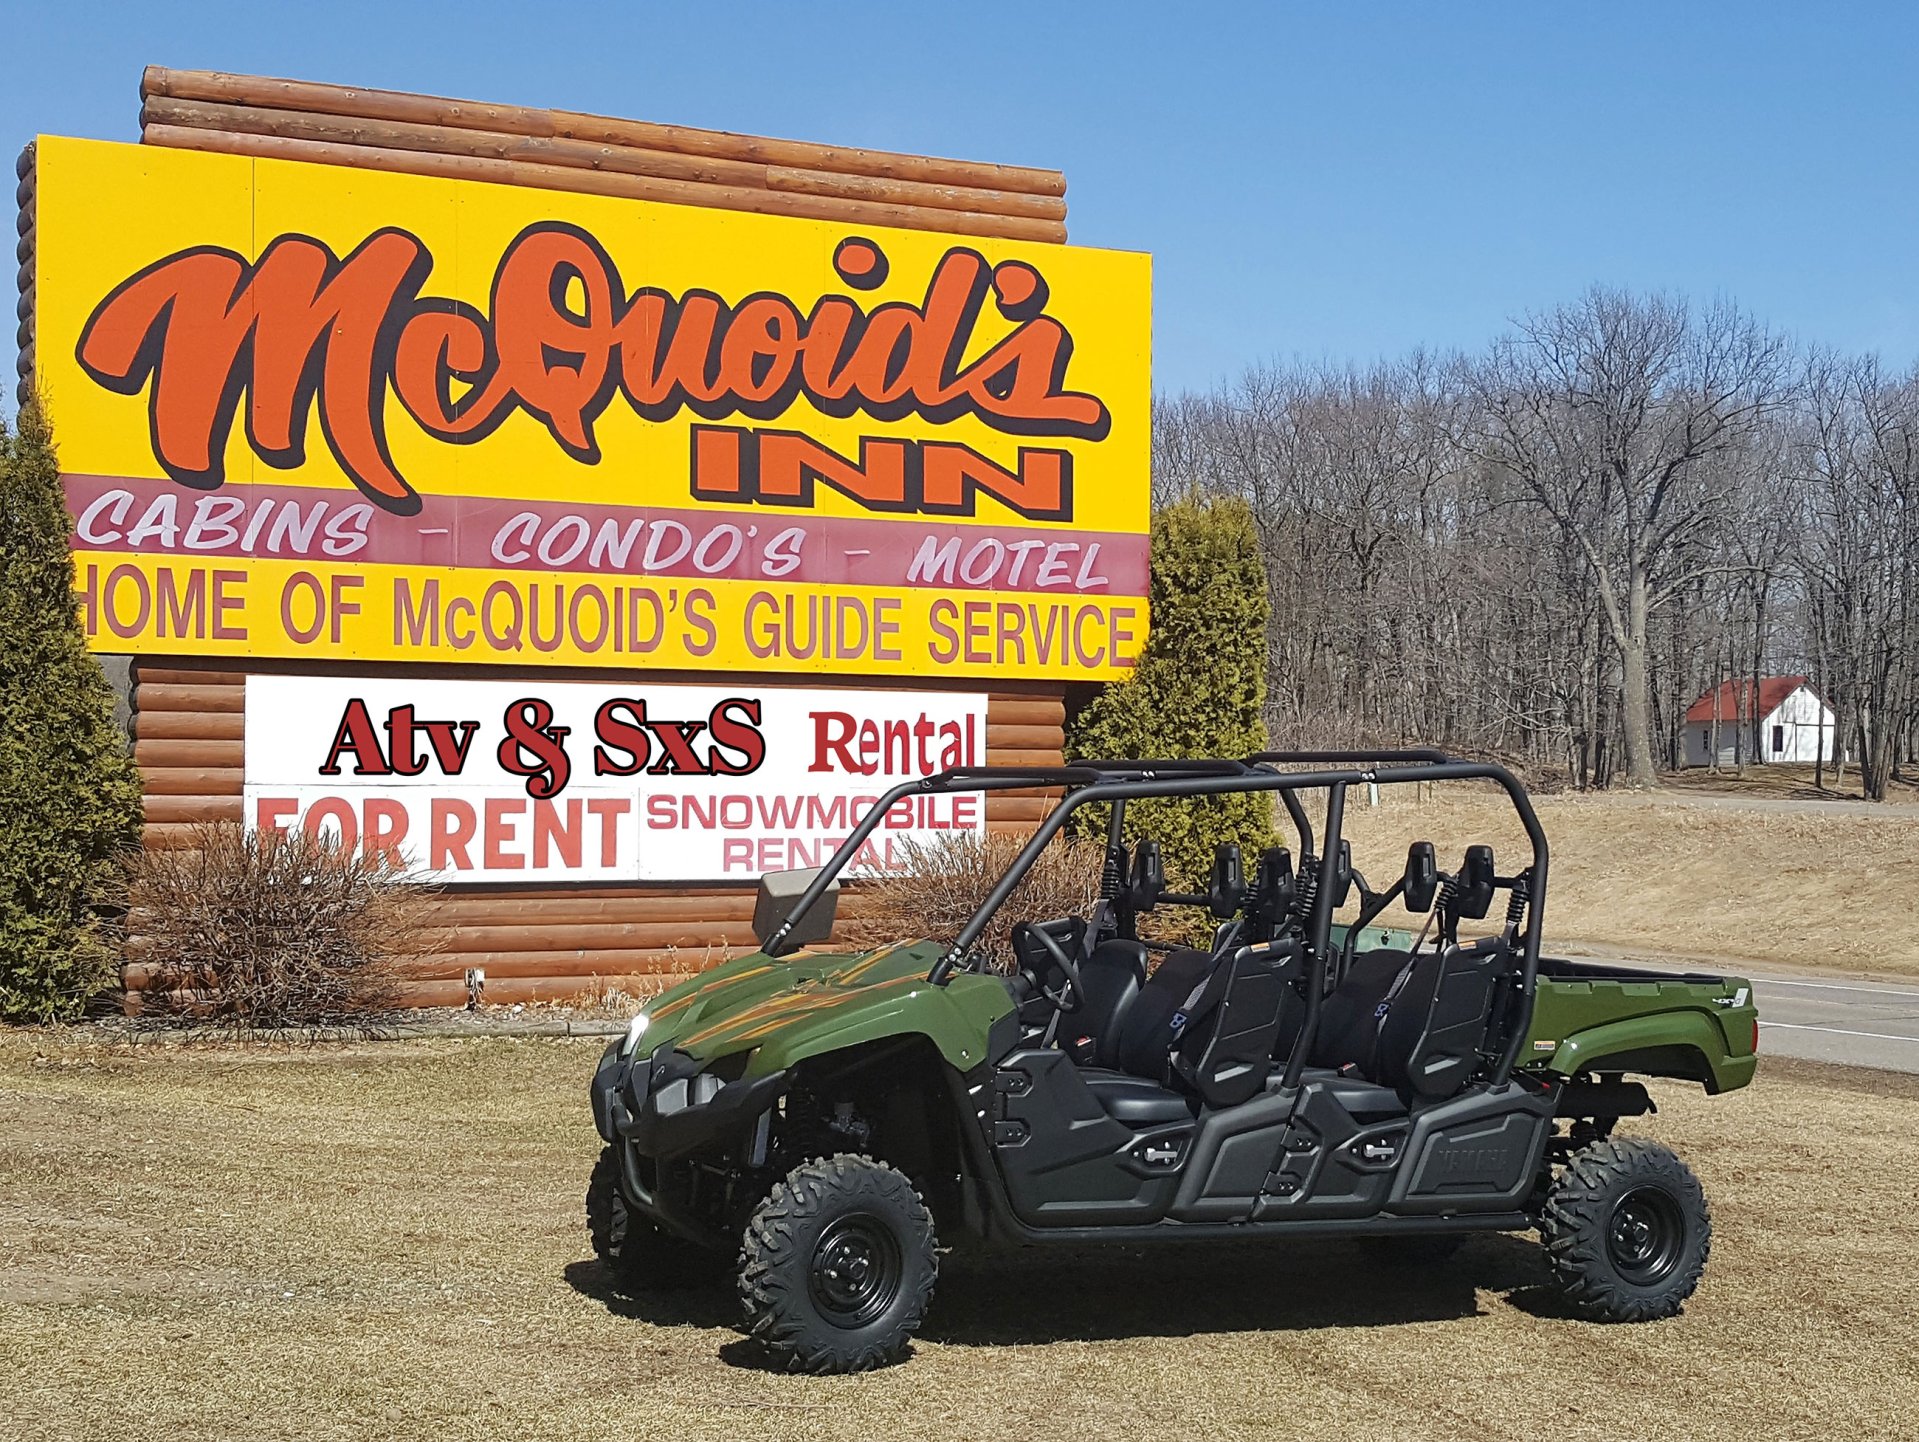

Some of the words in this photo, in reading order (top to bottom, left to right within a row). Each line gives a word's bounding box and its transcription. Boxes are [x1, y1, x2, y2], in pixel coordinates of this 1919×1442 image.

[75, 221, 1111, 516] McQuoid's
[690, 424, 1073, 522] INN
[76, 490, 374, 556] CABINS
[490, 512, 806, 577] CONDO'S
[907, 535, 1109, 589] MOTEL
[280, 571, 364, 644] OF
[393, 578, 717, 657] McQUOID'S
[743, 591, 902, 661] GUIDE
[927, 598, 1136, 668] SERVICE
[319, 698, 480, 776] Atv
[497, 698, 571, 800] &
[594, 697, 766, 776] SxS
[807, 711, 975, 776] Rental
[430, 797, 631, 870] RENT
[647, 794, 977, 829] SNOWMOBILE
